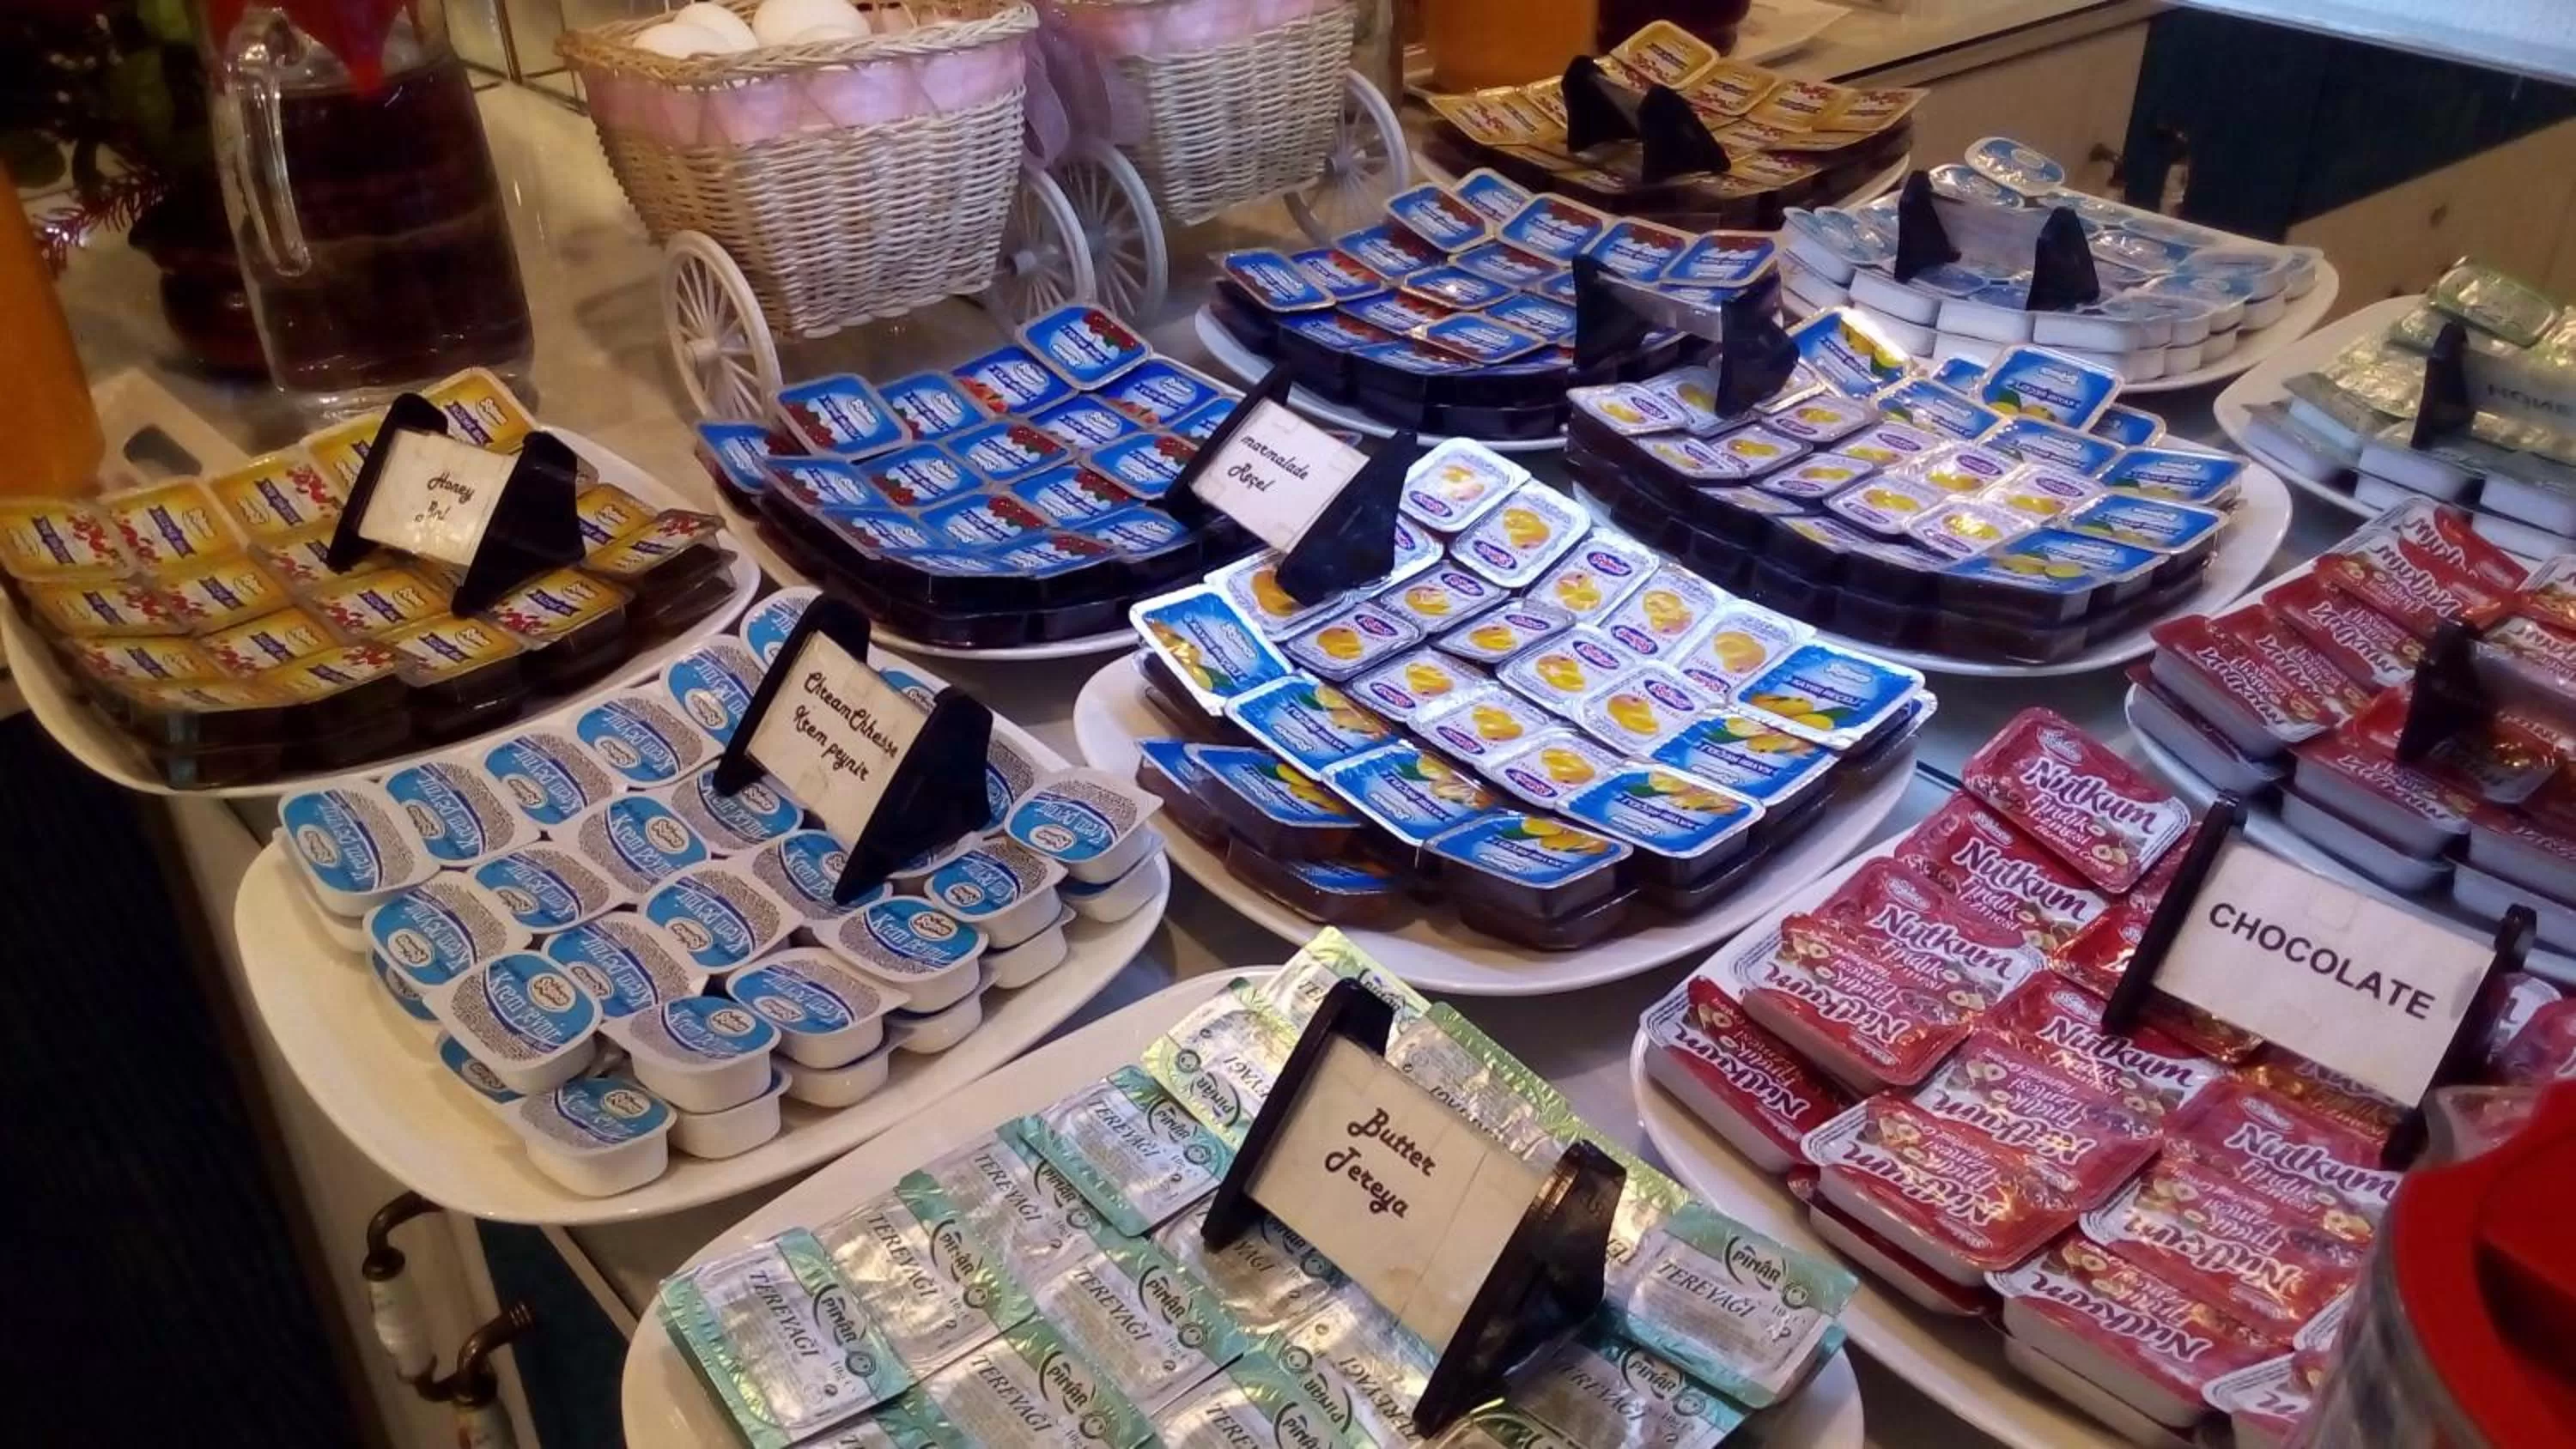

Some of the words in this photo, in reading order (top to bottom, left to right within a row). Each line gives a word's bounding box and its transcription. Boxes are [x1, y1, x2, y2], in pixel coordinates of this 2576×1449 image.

[428, 473, 475, 504] Honey
[1241, 435, 1310, 481] marmalade
[2021, 758, 2157, 835] Nutkum
[611, 814, 647, 855] Krem
[788, 848, 820, 888] Krem
[1951, 838, 2087, 923] Nutkum
[872, 912, 911, 943] Krem
[1868, 905, 2013, 980] Nutkum
[2209, 902, 2436, 1020] CHOCOLATE
[489, 971, 524, 1014] Krem
[1765, 962, 1911, 1045] Nutkum
[1674, 1022, 1812, 1120] Nutkum
[2036, 1016, 2195, 1087] Nutkum
[1347, 1107, 1437, 1177] Butter
[2223, 1122, 2402, 1203] Nutkum
[2032, 1272, 2214, 1363] Nutkum
[1206, 1405, 1259, 1449] TERE
